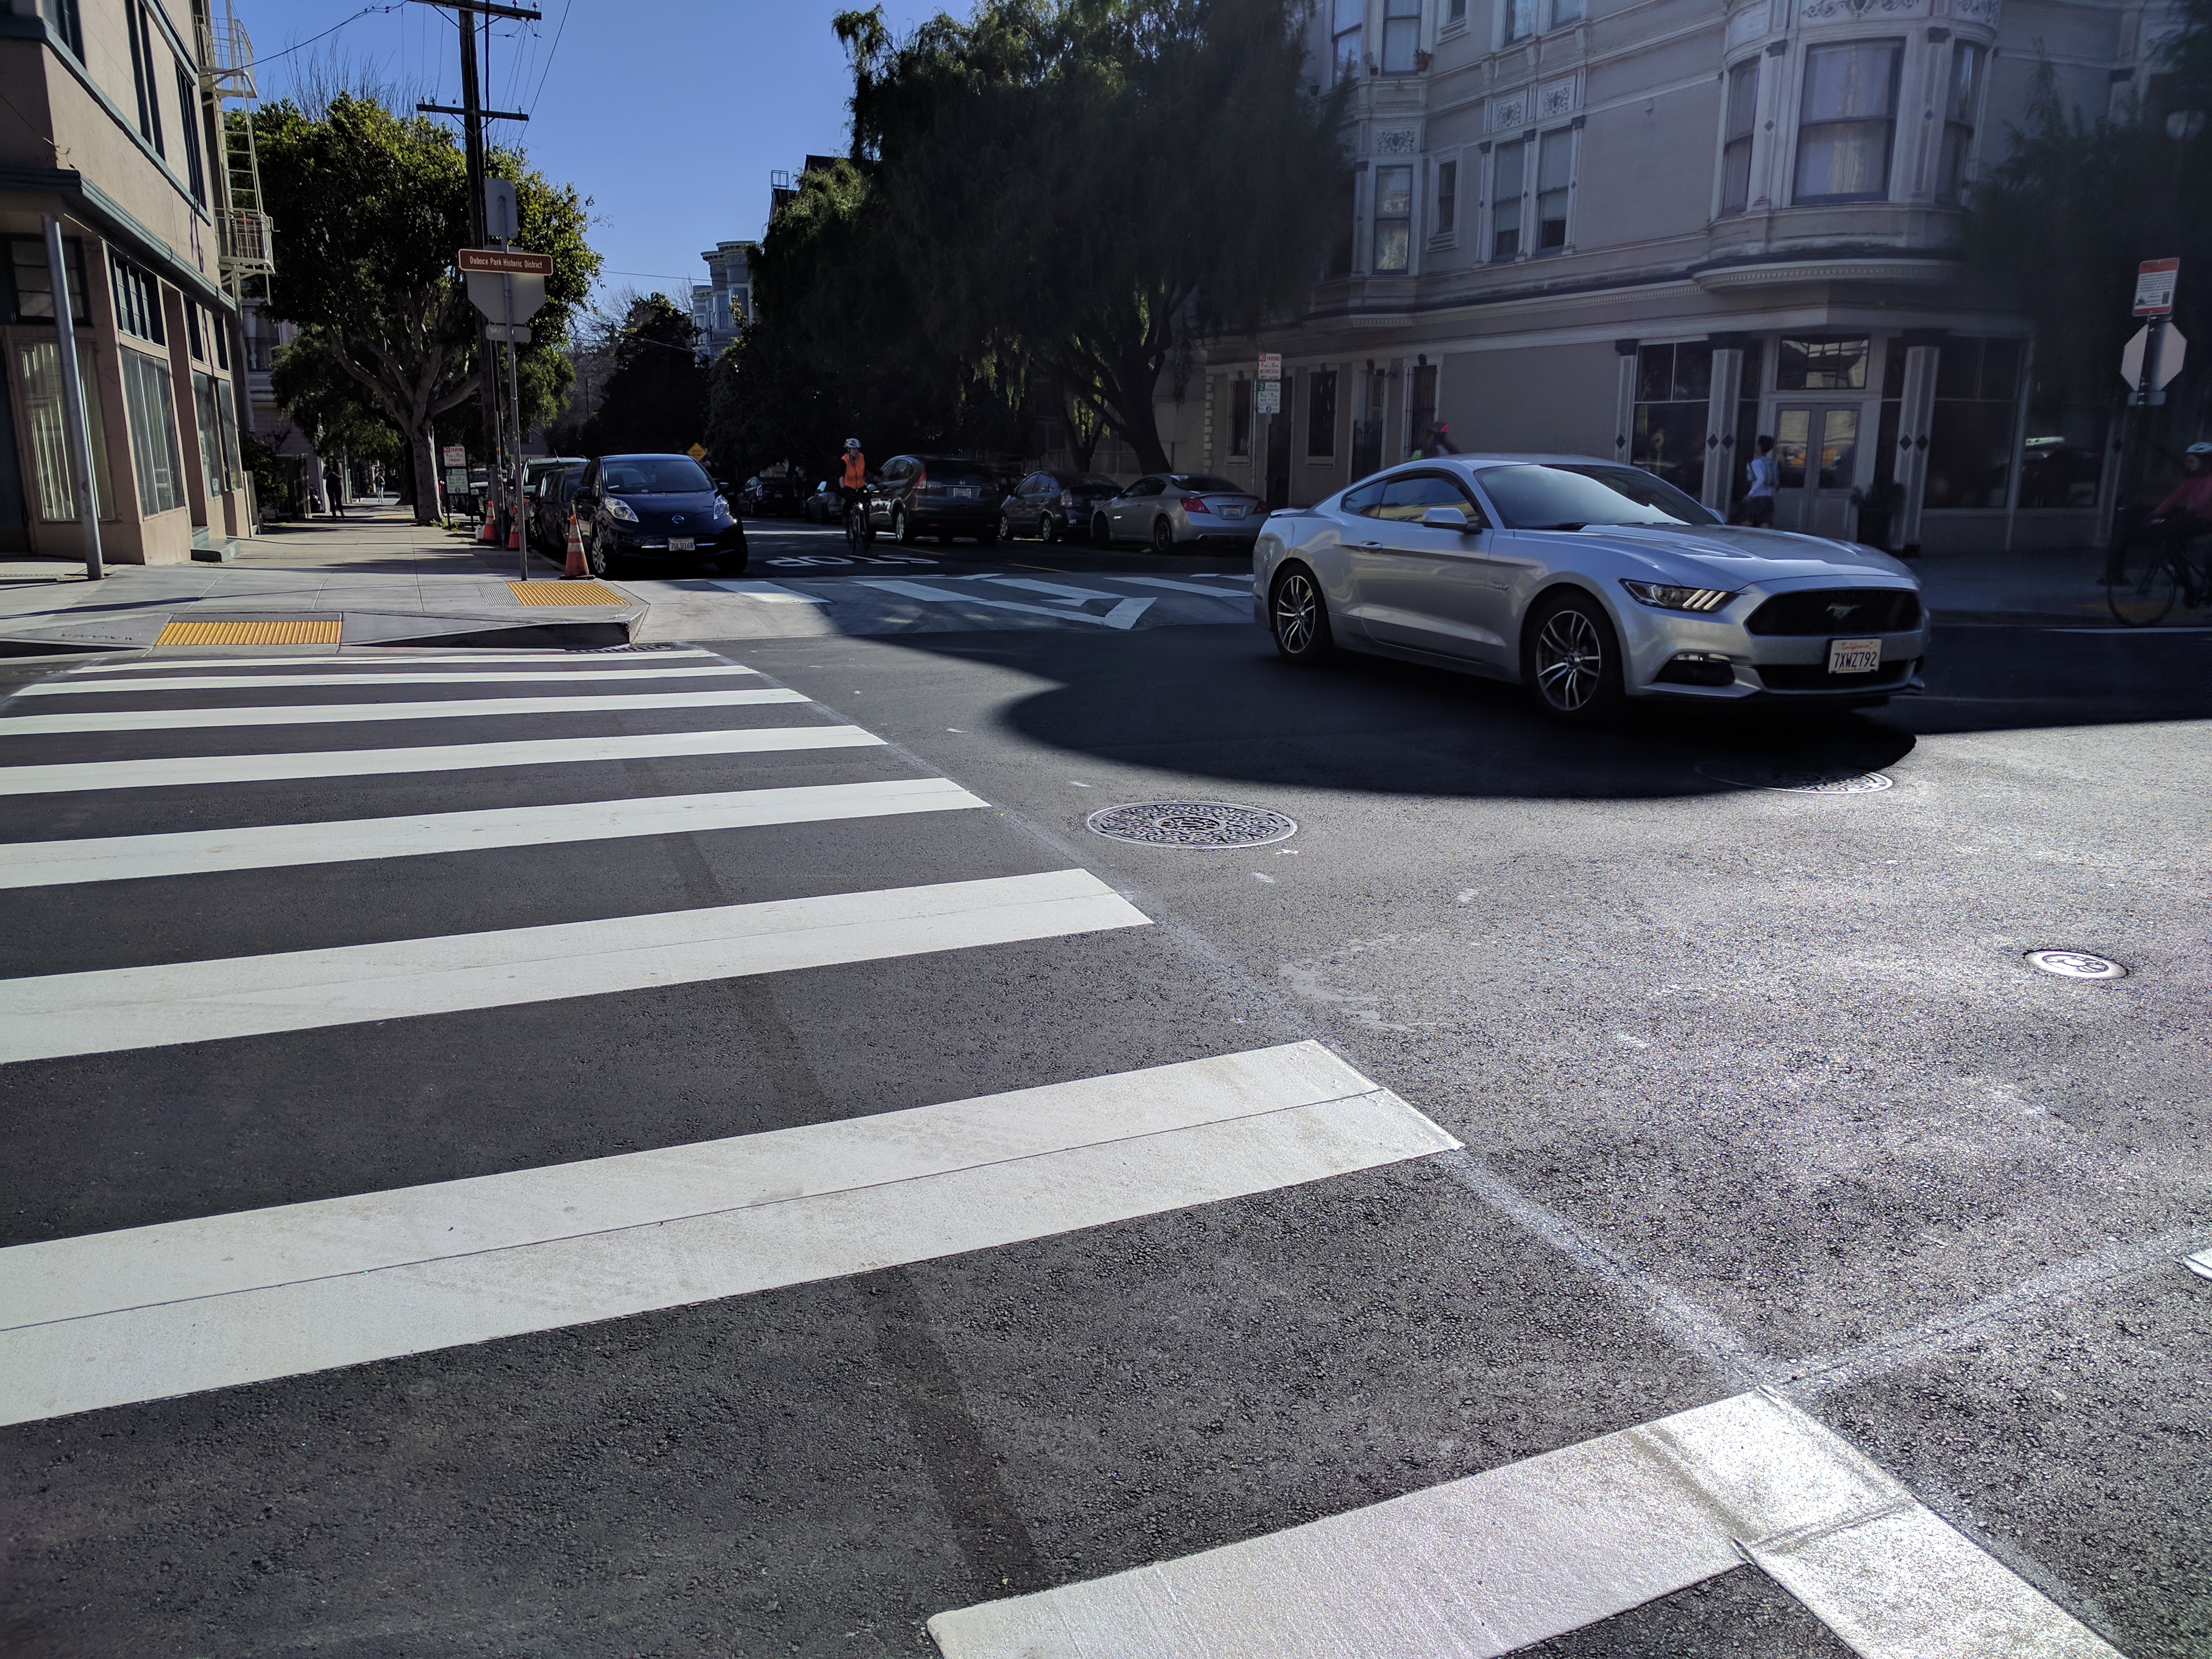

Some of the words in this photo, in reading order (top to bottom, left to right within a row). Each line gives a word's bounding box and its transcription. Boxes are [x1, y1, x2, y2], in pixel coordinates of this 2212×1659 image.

[470, 256, 488, 265] Duboce
[490, 257, 502, 266] Park
[503, 258, 522, 267] Historic
[524, 260, 543, 268] District
[1835, 652, 1877, 668] 7XWZ792
